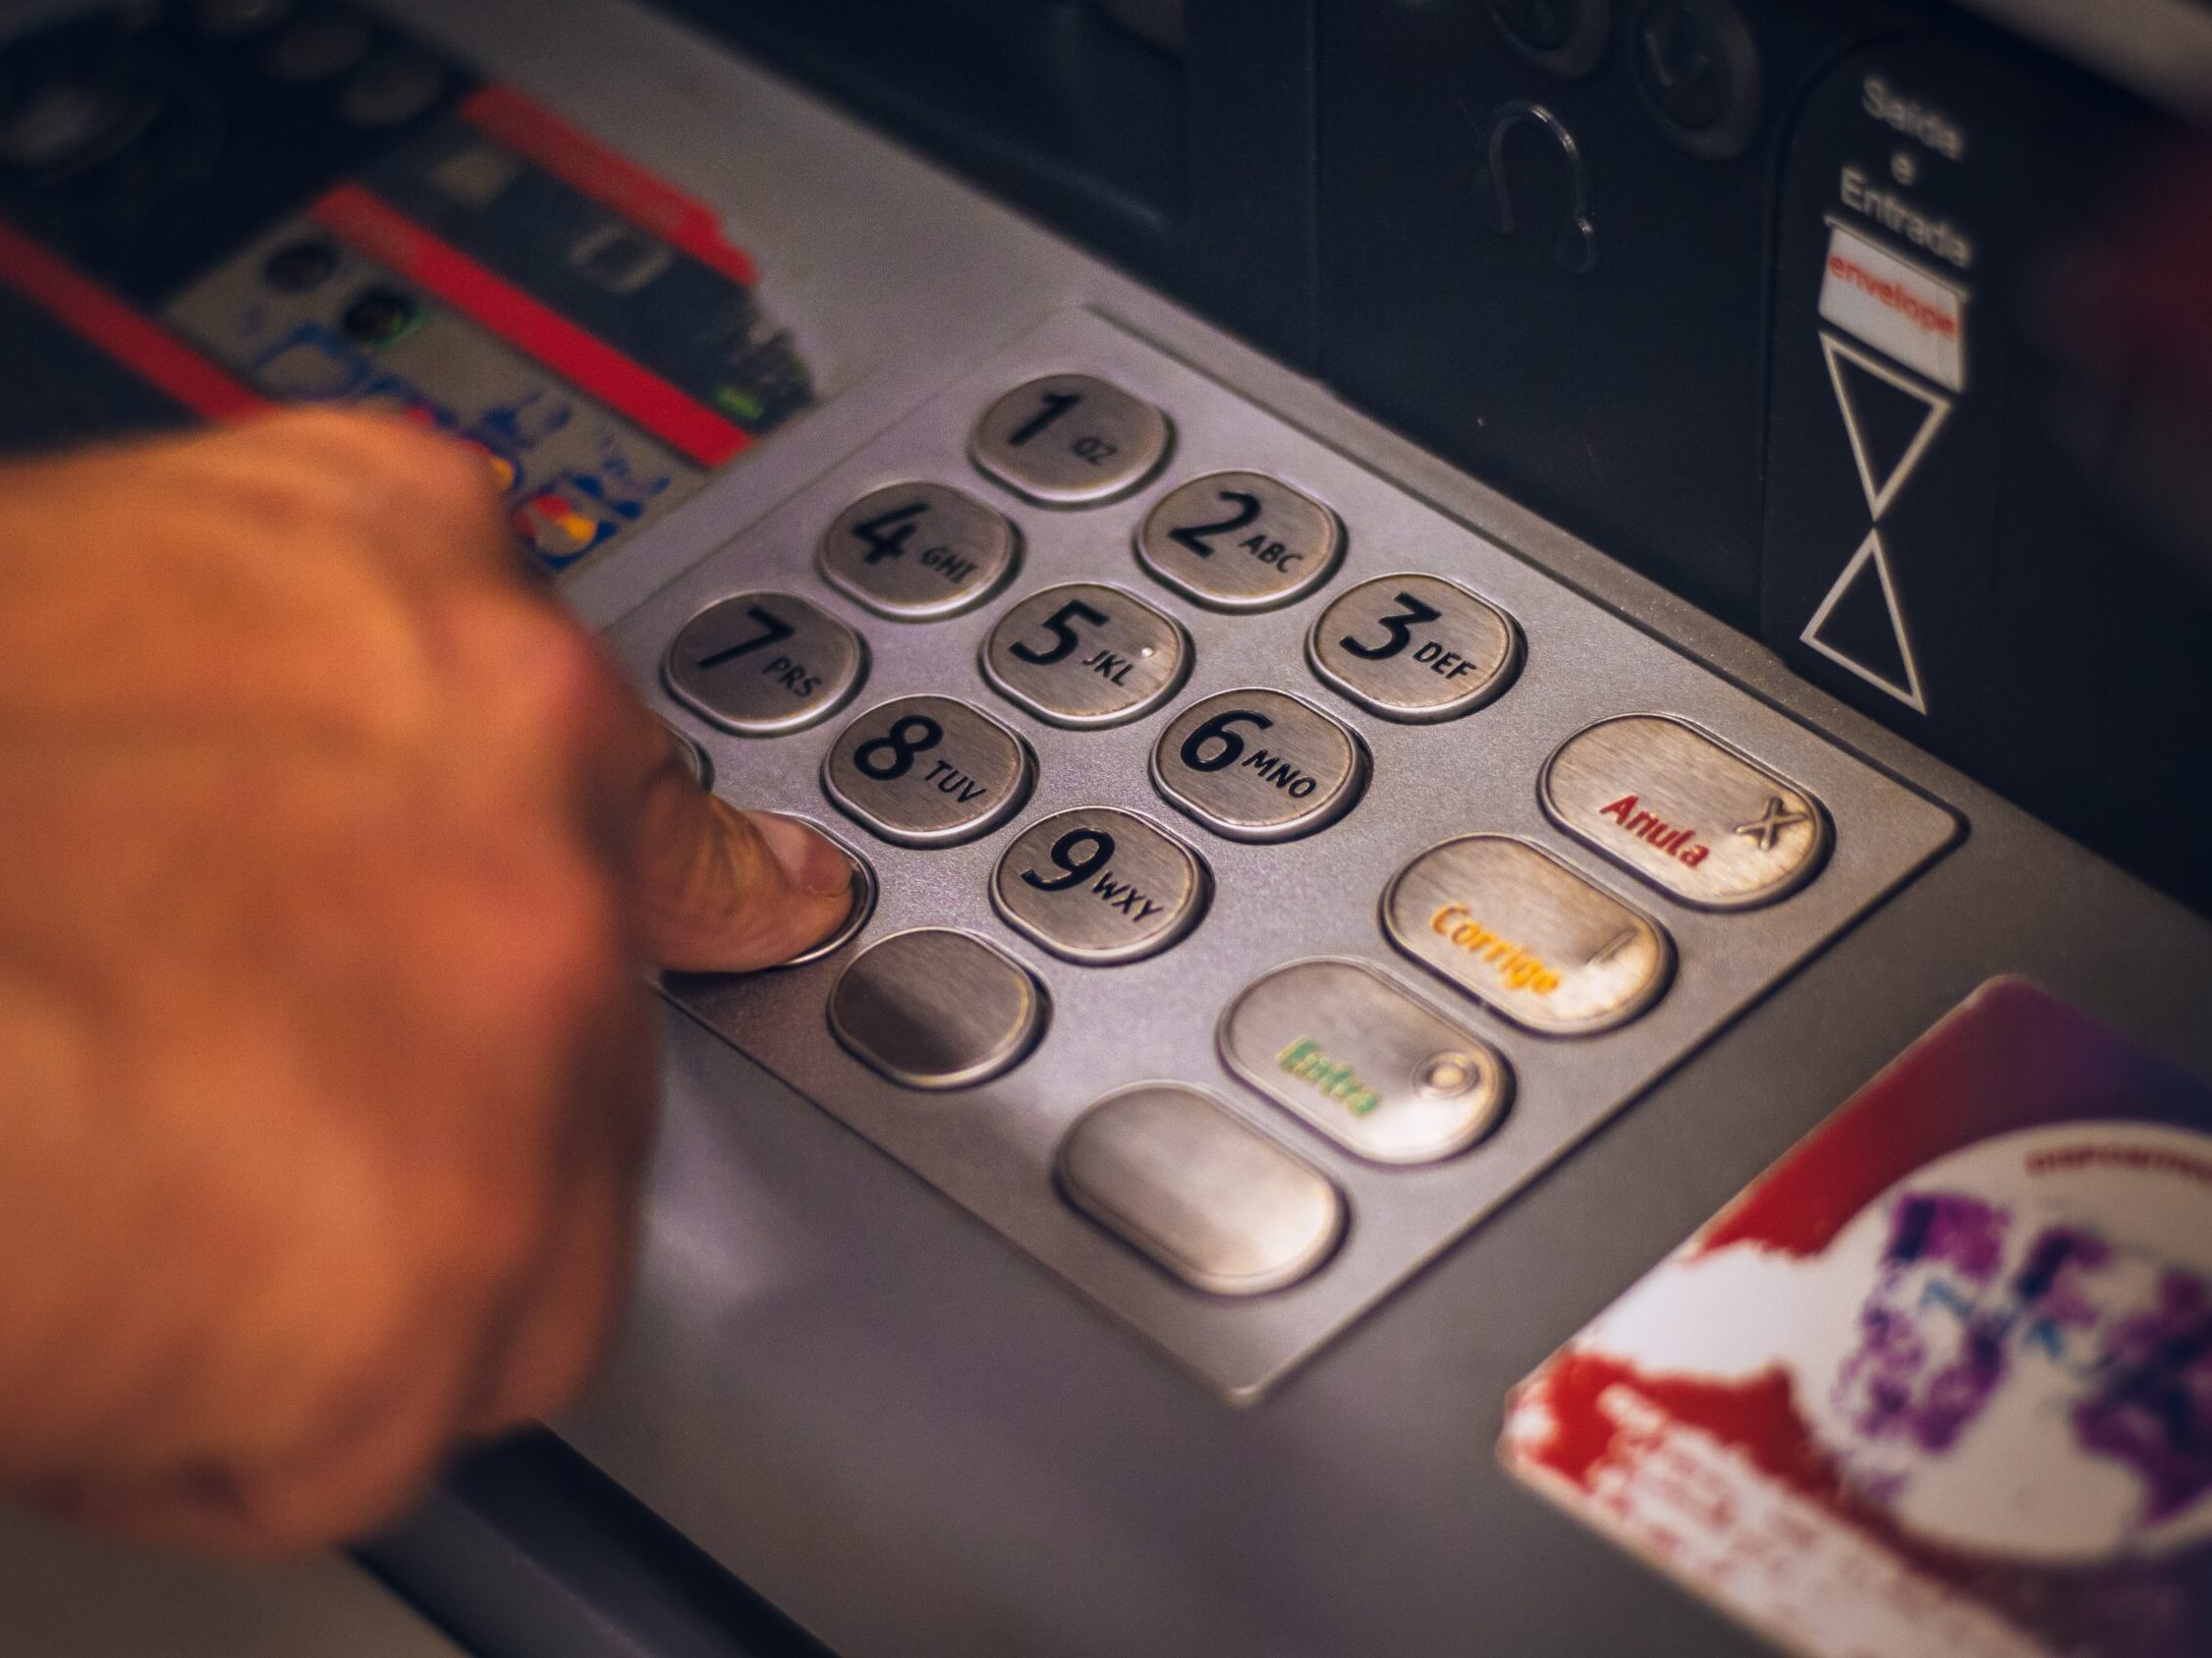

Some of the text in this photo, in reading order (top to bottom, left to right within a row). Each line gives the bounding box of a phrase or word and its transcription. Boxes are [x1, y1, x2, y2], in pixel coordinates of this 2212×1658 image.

[1891, 153, 1915, 186] e
[1841, 166, 1971, 267] Entrada
[1829, 255, 1957, 338] envelope
[1008, 392, 1080, 447] 1
[851, 501, 978, 583] 4 GHI
[1168, 491, 1304, 573] 2 ABC
[696, 606, 822, 697] 7 PRS
[1009, 599, 1134, 686] 5 JKL
[1339, 591, 1476, 680] 3 DEF
[854, 714, 987, 802] 8 TUV
[1181, 709, 1317, 798] 6 MNO
[1021, 827, 1163, 922] 9 WXY
[1599, 795, 1711, 868] Anula
[1430, 904, 1560, 995] Corrige
[1278, 1038, 1380, 1118] Entra
